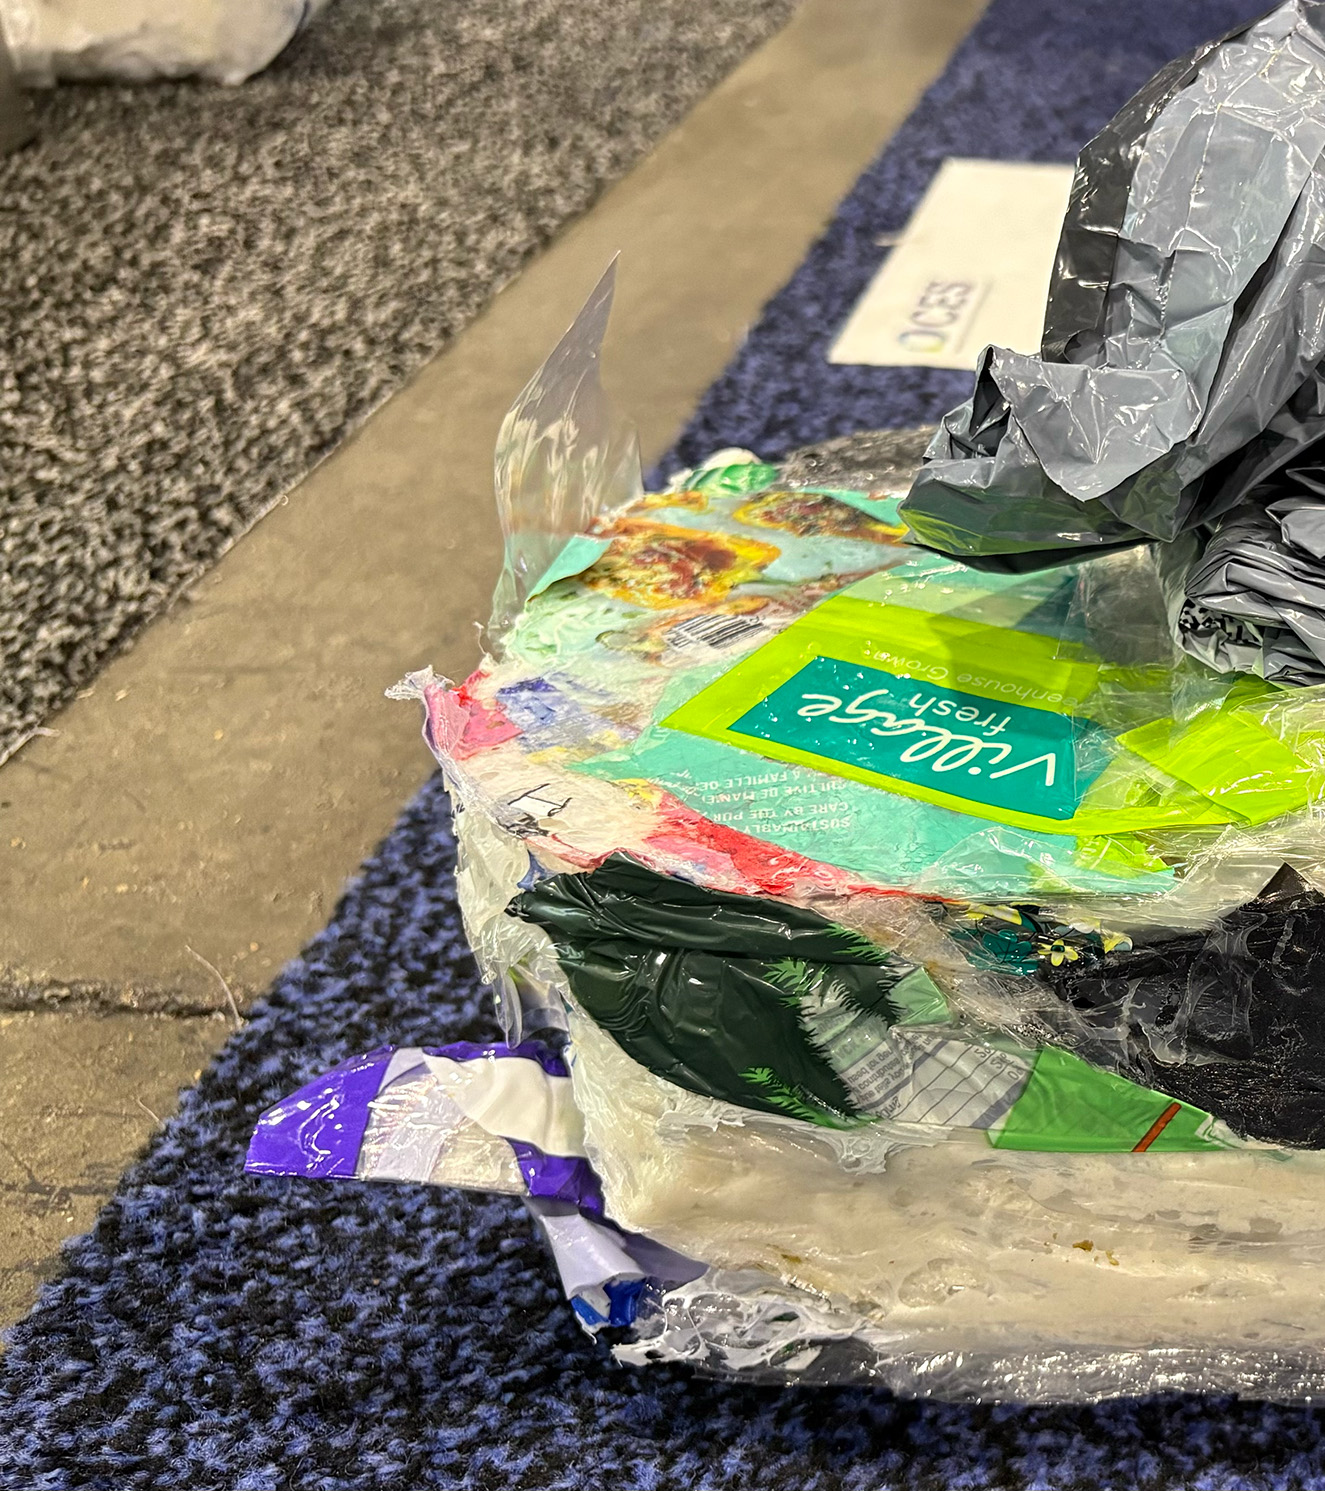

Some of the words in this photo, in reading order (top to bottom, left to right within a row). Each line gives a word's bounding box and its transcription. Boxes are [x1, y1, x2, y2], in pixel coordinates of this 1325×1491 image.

[872, 648, 949, 679] Grown
[957, 672, 1079, 709] eenhouse
[909, 692, 1011, 737] fresh
[797, 689, 1056, 786] Village
[724, 771, 788, 789] FAMILLE
[760, 787, 779, 799] DE
[784, 805, 804, 817] BY
[808, 801, 848, 815] CARE
